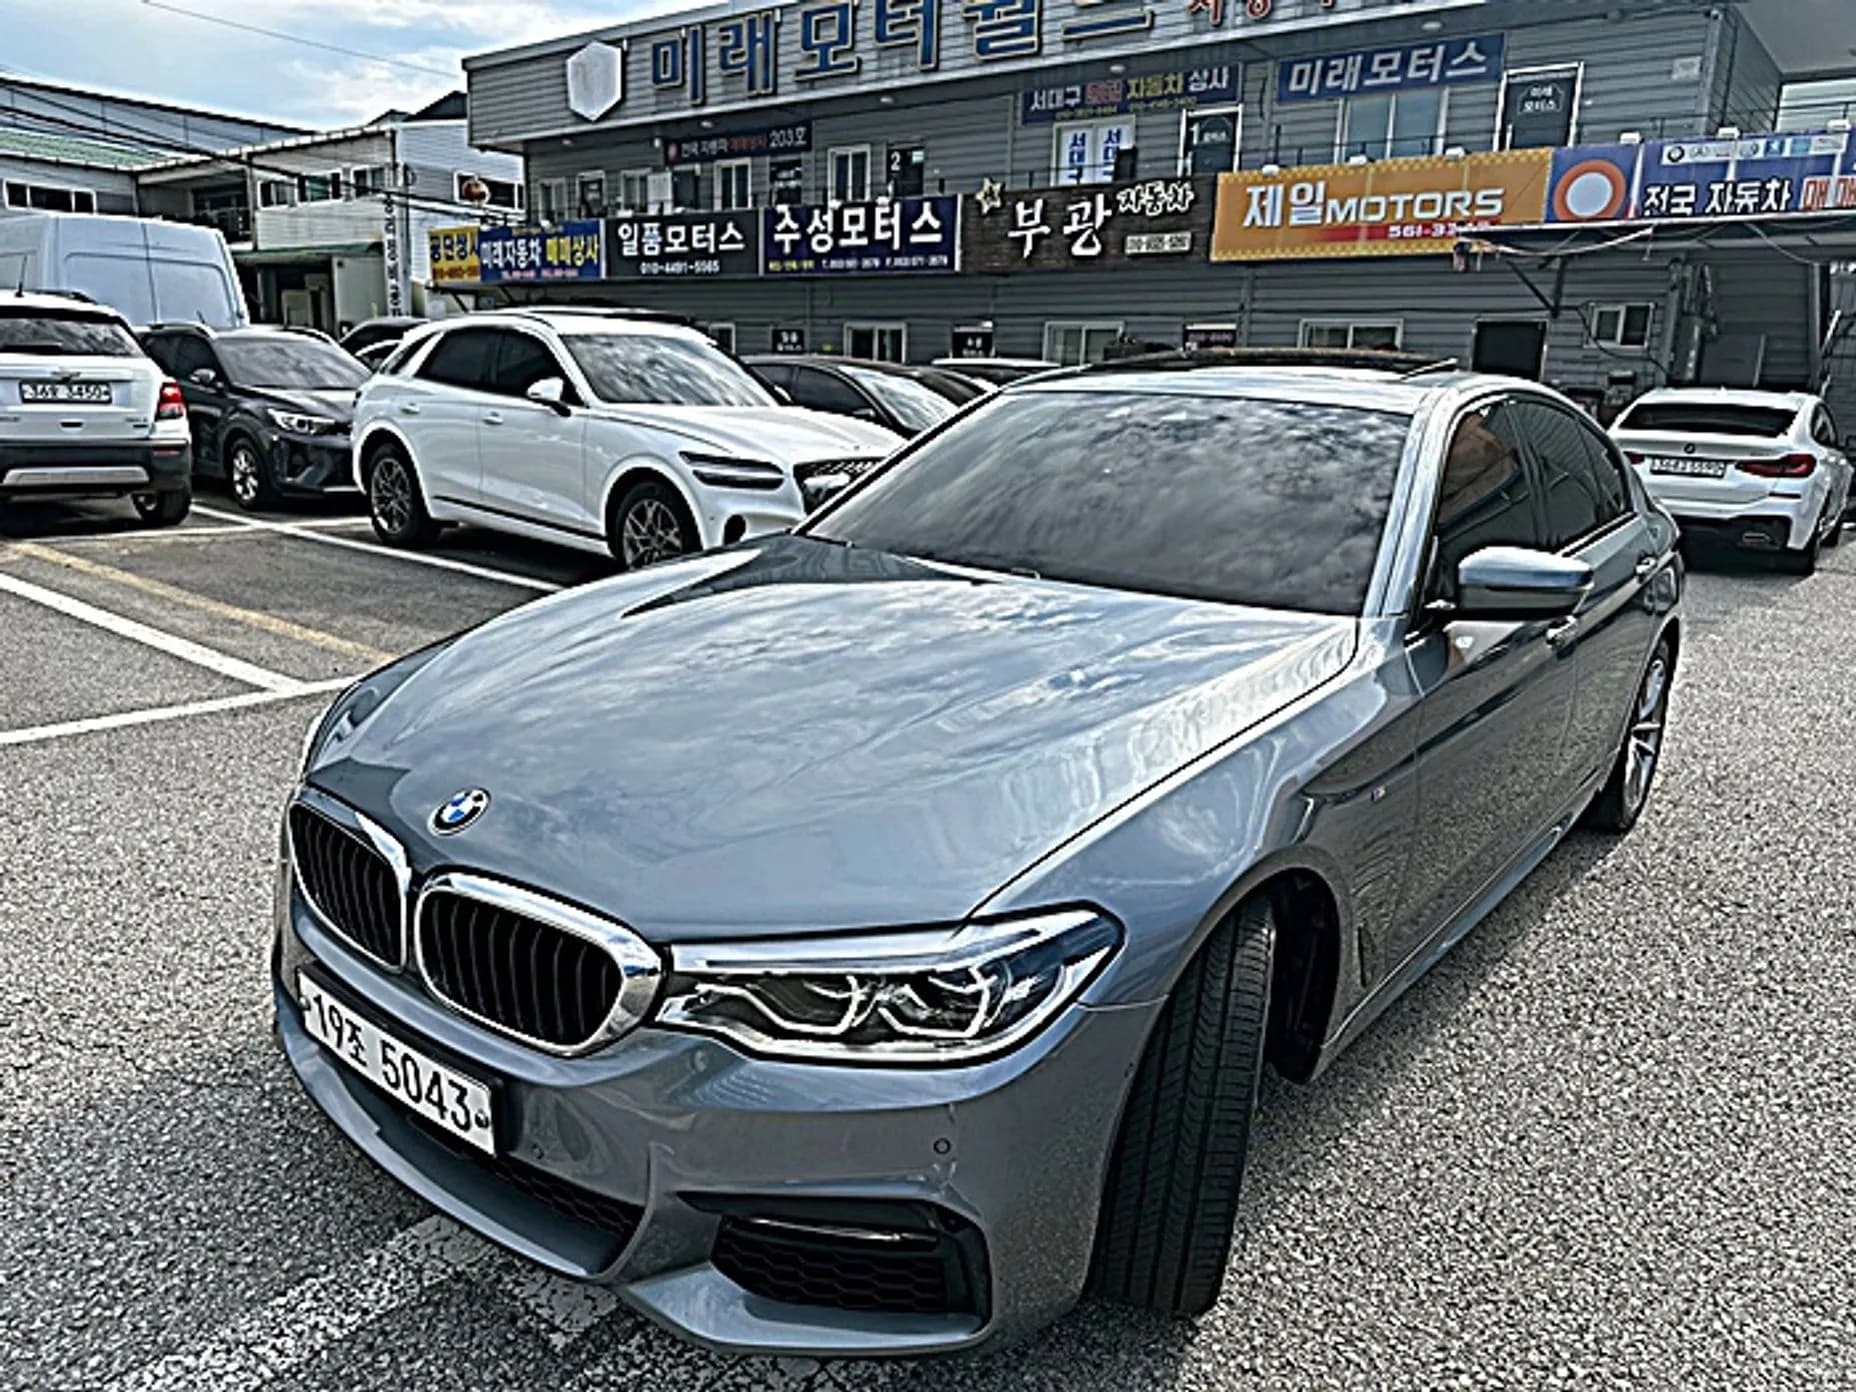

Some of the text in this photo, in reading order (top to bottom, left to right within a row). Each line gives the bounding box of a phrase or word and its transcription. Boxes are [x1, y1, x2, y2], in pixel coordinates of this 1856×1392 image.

[1289, 41, 1487, 95] 미래모터스
[1030, 85, 1081, 111] 서대구
[1127, 72, 1184, 99] 자동차
[1188, 66, 1230, 92] 상사
[890, 151, 901, 171] 2
[1116, 181, 1195, 216] 자동차
[1643, 184, 1697, 216] 전국
[1705, 178, 1791, 214] 자동차
[617, 222, 746, 256] 일품모터스
[773, 201, 943, 254] 주성모터스
[481, 234, 599, 269] 미래자동차 매매상사
[379, 1038, 471, 1132] 5043
